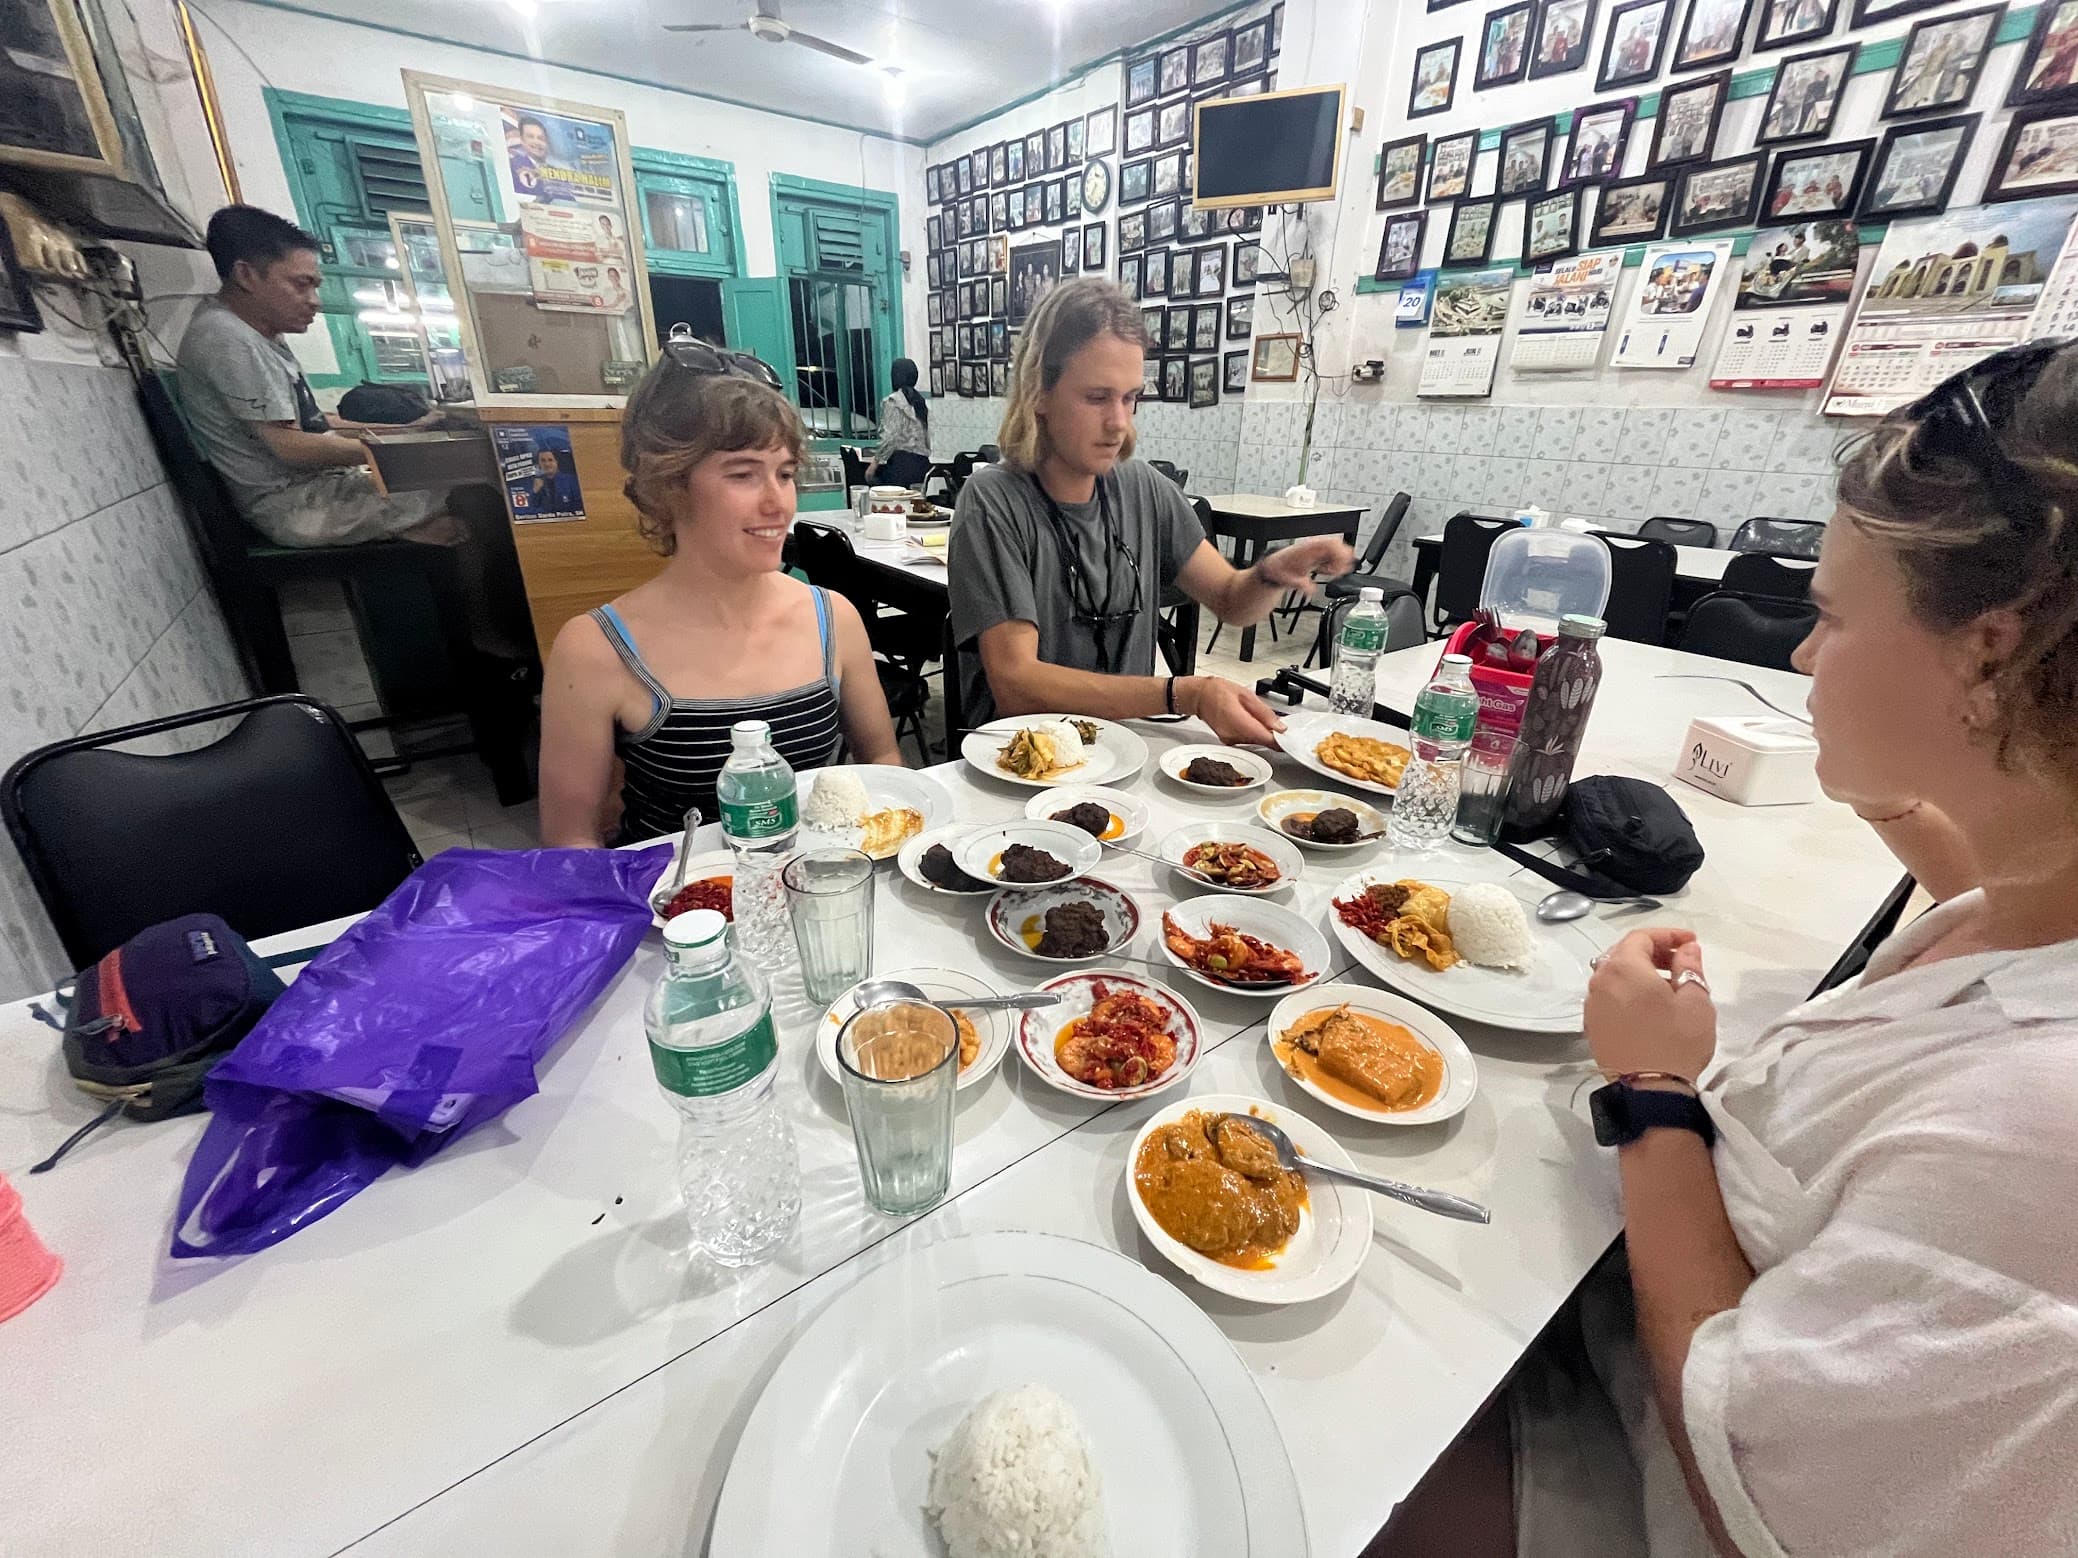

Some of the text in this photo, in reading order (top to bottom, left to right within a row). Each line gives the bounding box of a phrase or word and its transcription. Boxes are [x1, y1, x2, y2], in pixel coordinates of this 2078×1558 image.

[1576, 257, 1602, 271] SIAP
[1553, 271, 1588, 287] JALANI
[1402, 297, 1421, 308] 20
[1493, 699, 1517, 713] Gas
[755, 817, 776, 827] SMS
